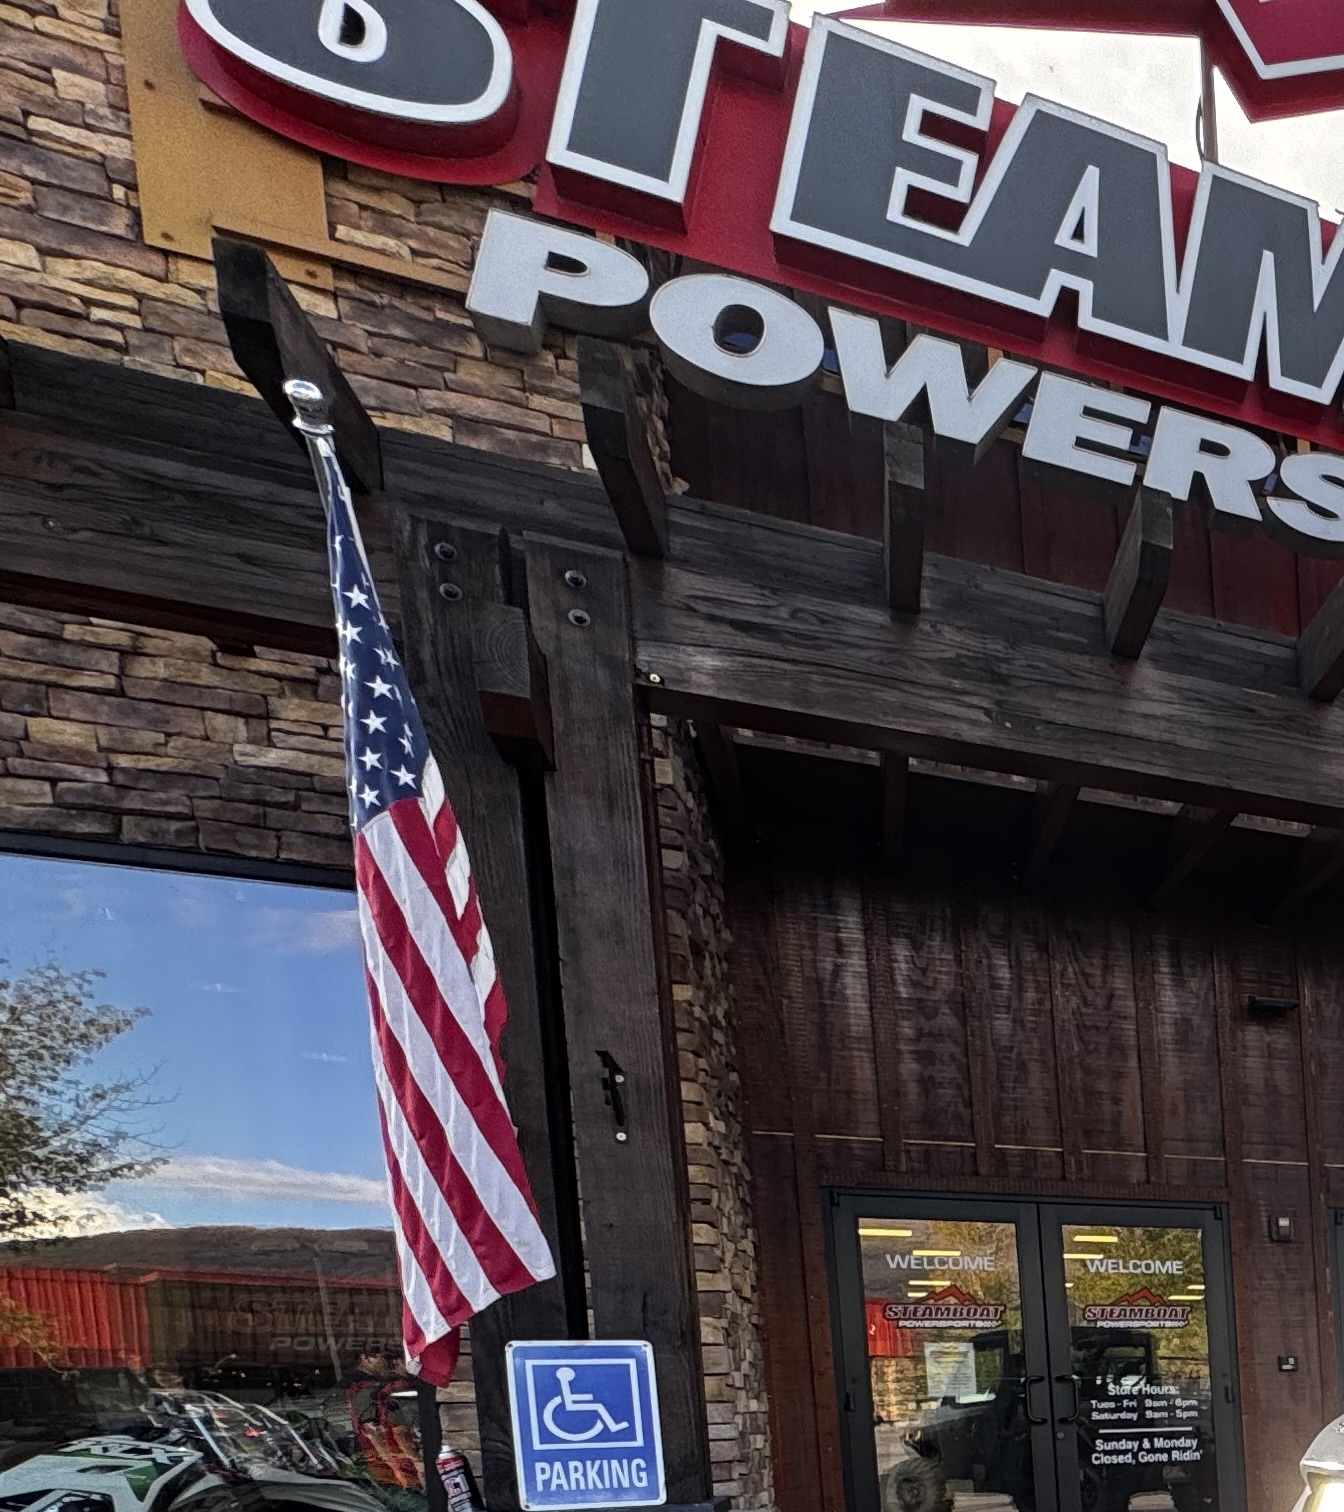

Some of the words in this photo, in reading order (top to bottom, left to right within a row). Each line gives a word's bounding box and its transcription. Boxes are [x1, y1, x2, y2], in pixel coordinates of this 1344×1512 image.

[885, 1253, 996, 1271] WELCOME
[1086, 1258, 1184, 1274] WELCOME
[885, 1304, 1005, 1320] STEAMBOAT
[1086, 1305, 1190, 1320] STEAMBOAT
[1107, 1383, 1139, 1396] Store
[1142, 1383, 1180, 1395] Hours:
[1090, 1400, 1116, 1409] Tues
[1123, 1399, 1137, 1408] Fri
[1091, 1411, 1138, 1421] Saturday
[1095, 1439, 1139, 1451] Sunday
[1142, 1438, 1151, 1449] &
[1154, 1437, 1198, 1450] Monday
[1091, 1452, 1136, 1465] Closed,
[1138, 1451, 1168, 1463] Gone
[1171, 1449, 1203, 1461] Ridin'
[534, 1457, 649, 1493] PARKING
